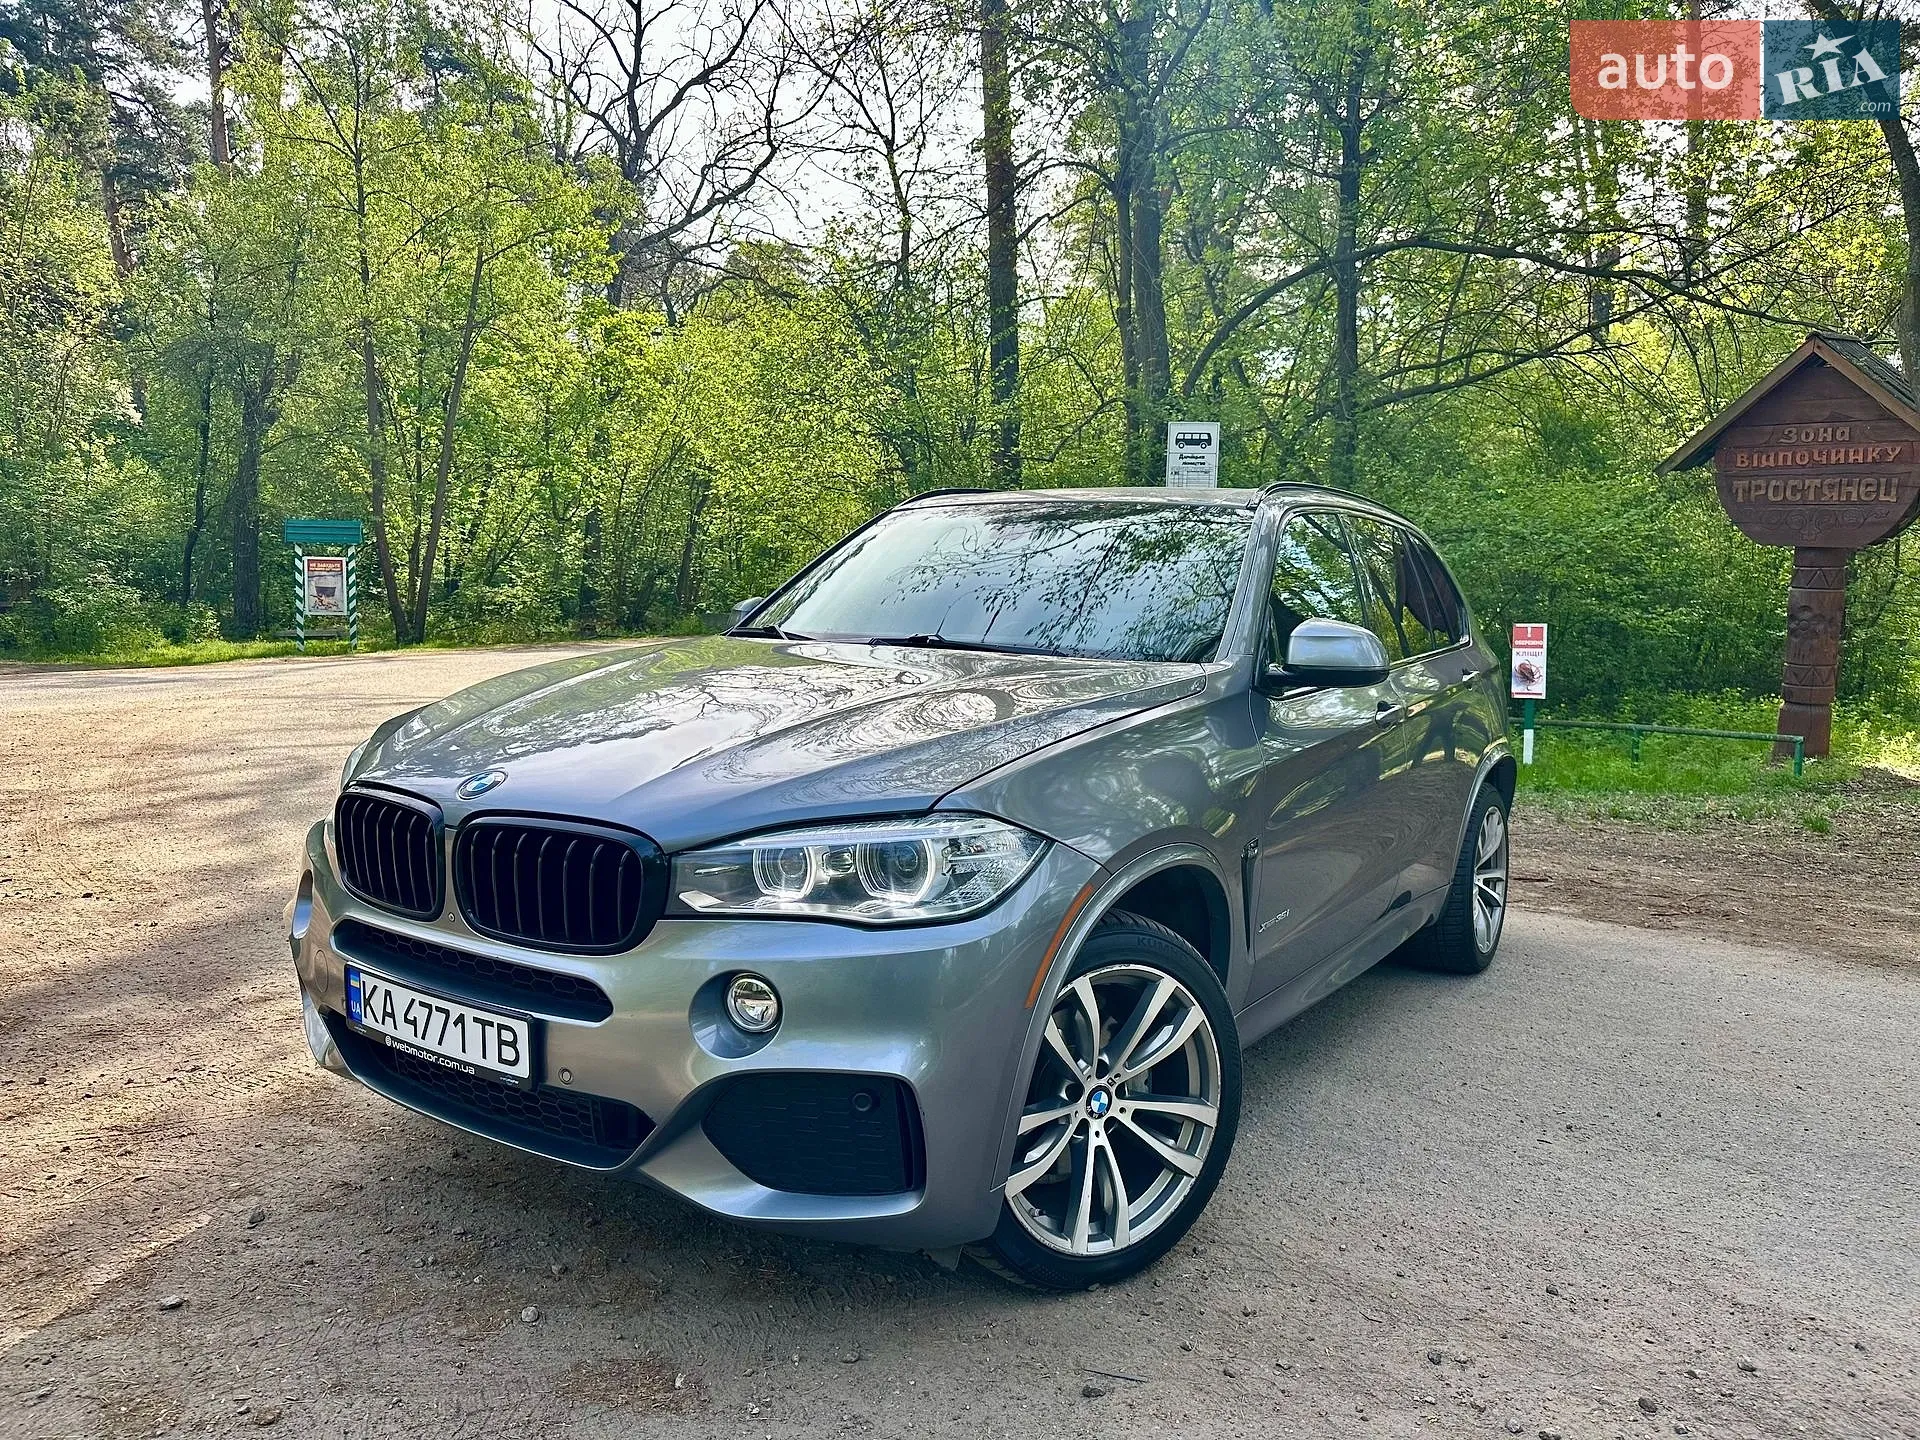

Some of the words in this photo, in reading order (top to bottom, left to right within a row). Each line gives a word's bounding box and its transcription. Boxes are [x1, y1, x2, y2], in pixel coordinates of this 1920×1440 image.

[351, 1001, 362, 1015] UA
[362, 980, 398, 1031] KA
[403, 997, 467, 1054] 4771
[472, 1016, 520, 1067] TB
